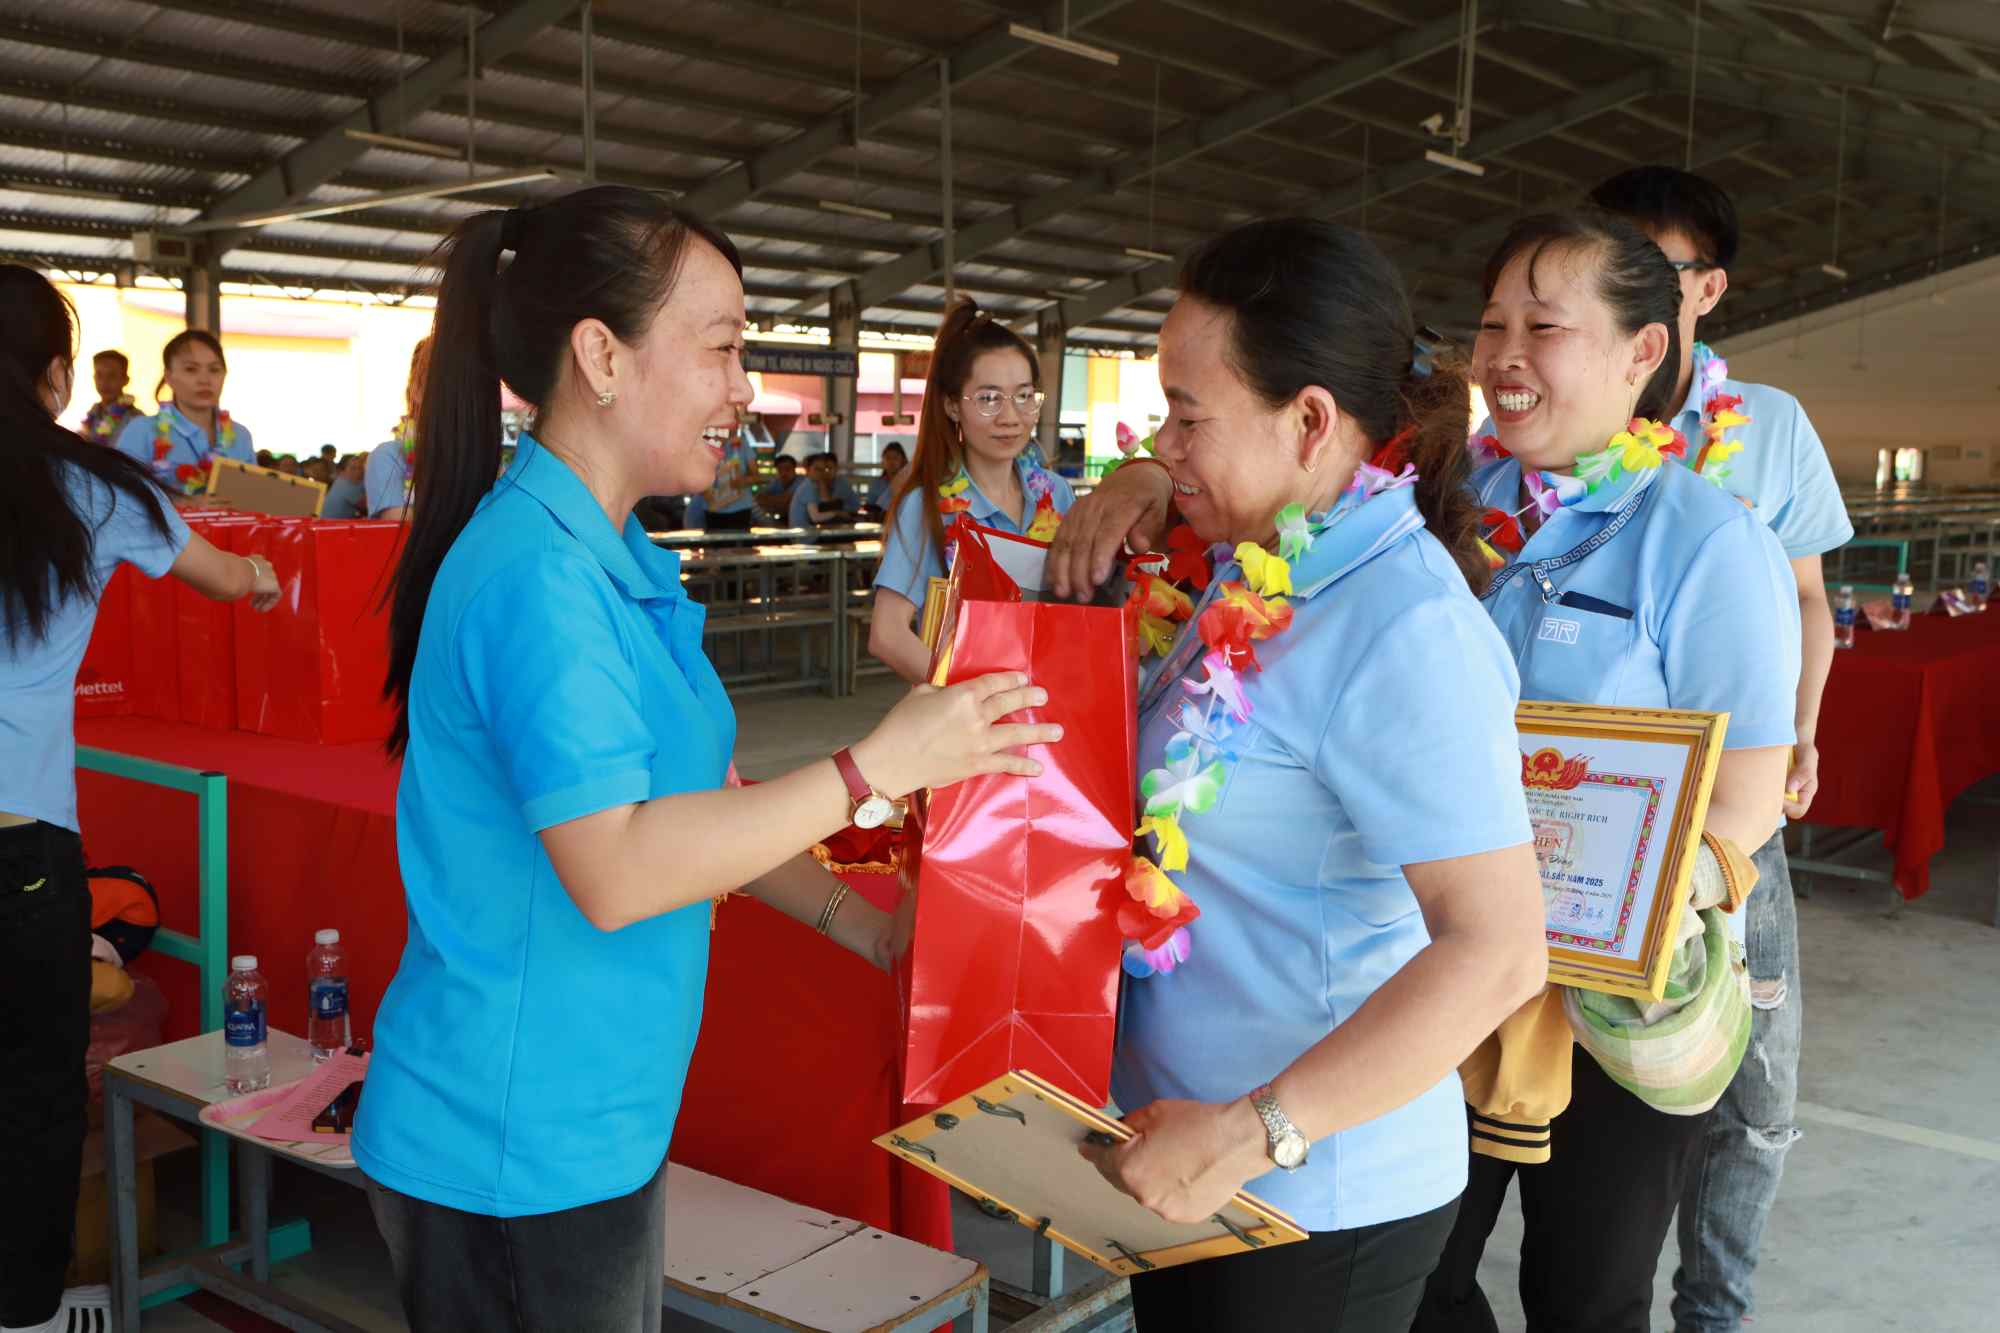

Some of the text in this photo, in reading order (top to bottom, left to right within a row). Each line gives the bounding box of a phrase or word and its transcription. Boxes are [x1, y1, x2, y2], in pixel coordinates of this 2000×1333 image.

[1559, 810, 1586, 822] RIGHT
[1587, 814, 1609, 824] RICH
[1534, 834, 1562, 849] HEN
[1585, 876, 1604, 888] 2025
